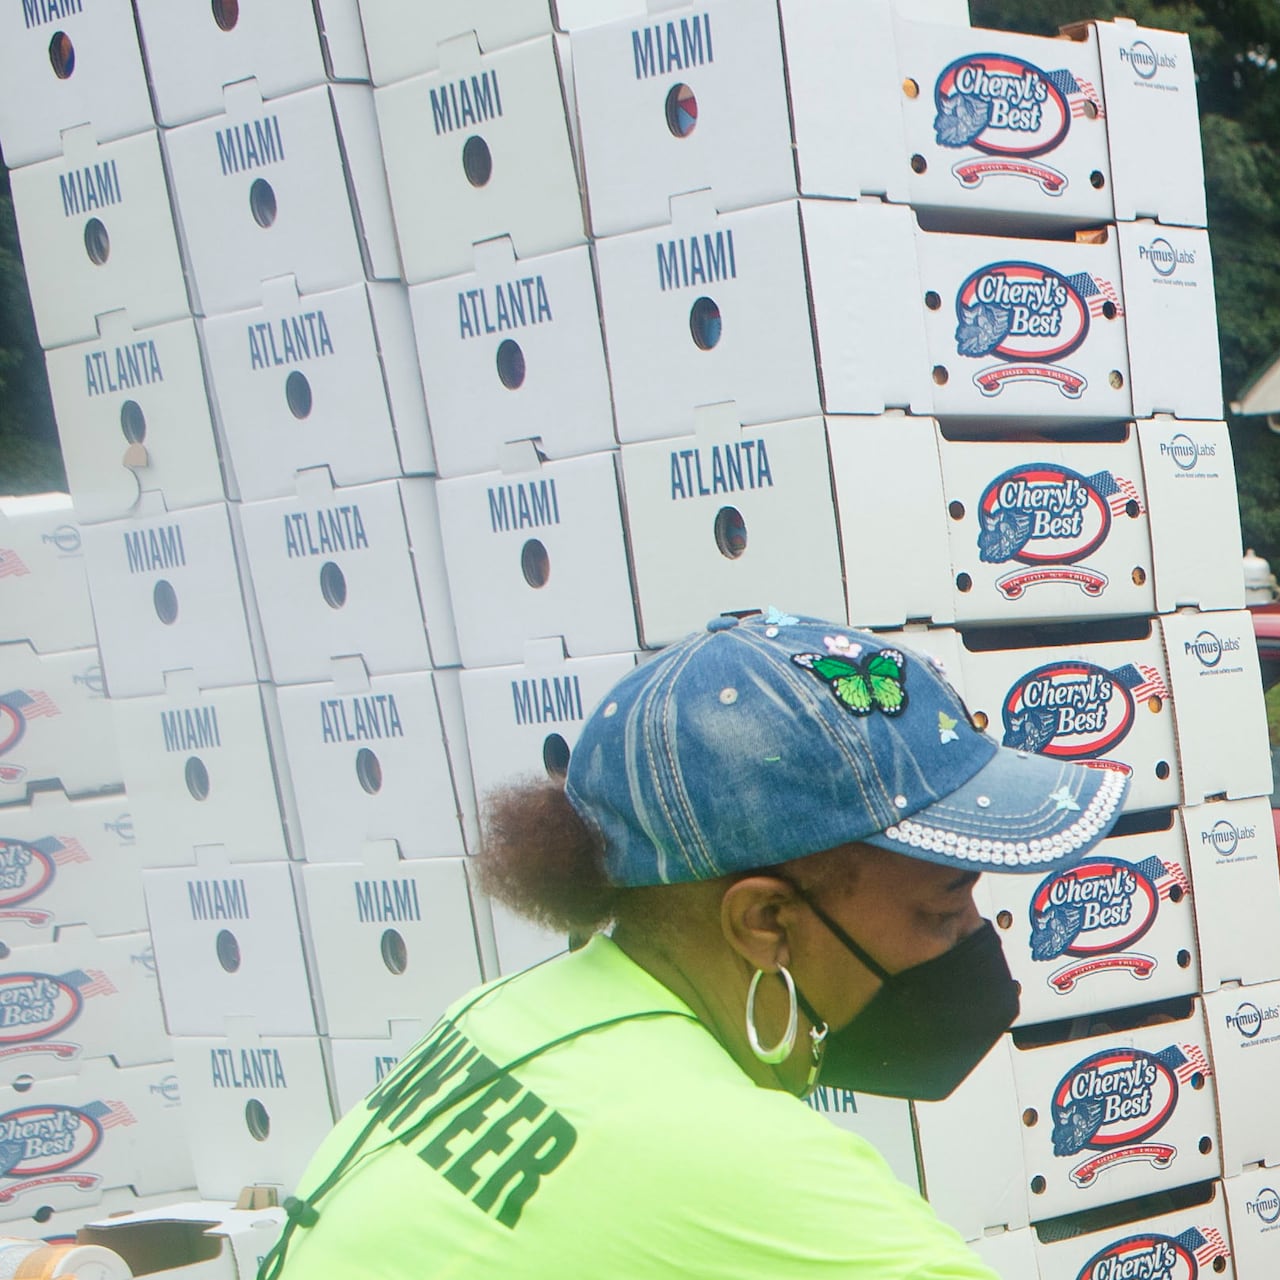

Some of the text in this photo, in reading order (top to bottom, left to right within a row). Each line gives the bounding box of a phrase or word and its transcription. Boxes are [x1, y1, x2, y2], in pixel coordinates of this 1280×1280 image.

[632, 13, 714, 80] MIAMI
[430, 70, 503, 135] MIAMI
[954, 66, 1047, 106] Cheryl's
[988, 101, 1042, 131] Best
[215, 116, 285, 175] MIAMI
[59, 160, 121, 217] MIAMI
[656, 229, 737, 291] MIAMI
[457, 275, 553, 340] ATLANTA
[977, 272, 1068, 313] Cheryl's
[248, 310, 334, 370] ATLANTA
[1008, 307, 1062, 337] Best
[85, 340, 164, 397] ATLANTA
[670, 439, 773, 500] ATLANTA
[487, 479, 561, 533] MIAMI
[998, 479, 1089, 515] Cheryl's
[283, 505, 369, 557] ATLANTA
[1032, 509, 1082, 538] Best
[124, 525, 187, 573] MIAMI
[511, 676, 584, 725] MIAMI
[1023, 676, 1113, 712] Cheryl's
[160, 706, 221, 752] MIAMI
[319, 694, 404, 743] ATLANTA
[1057, 706, 1107, 736] Best
[187, 878, 250, 921] MIAMI
[354, 878, 421, 923] MIAMI
[1050, 868, 1137, 905] Cheryl's
[1083, 898, 1131, 930] Best
[0, 979, 59, 1004] eryl's
[210, 1048, 287, 1088] ATLANTA
[1071, 1059, 1157, 1099] Cheryl's
[1103, 1090, 1151, 1125] Best
